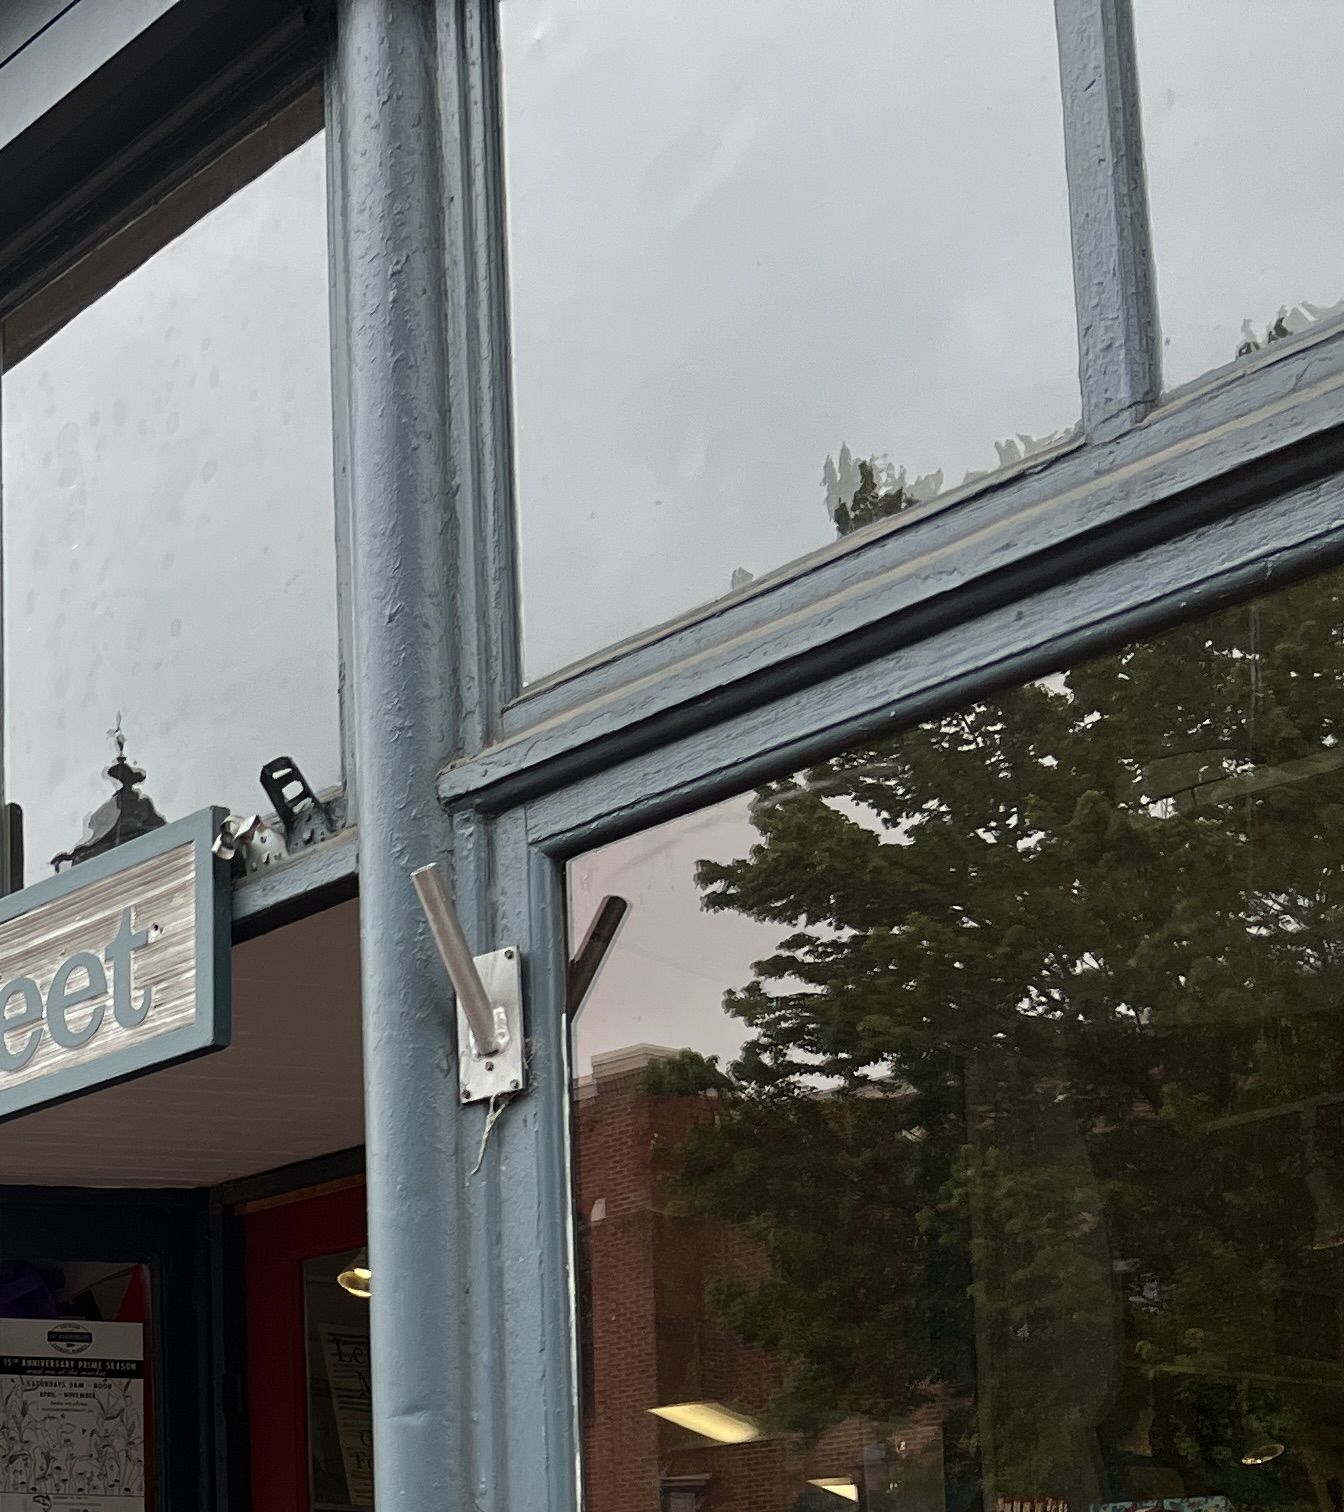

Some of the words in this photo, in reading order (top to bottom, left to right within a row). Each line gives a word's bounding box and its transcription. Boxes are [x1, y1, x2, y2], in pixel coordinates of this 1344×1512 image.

[21, 1359, 76, 1369] ANNIVERSARY
[78, 1361, 102, 1370] PRIME
[106, 1362, 137, 1371] SEASON
